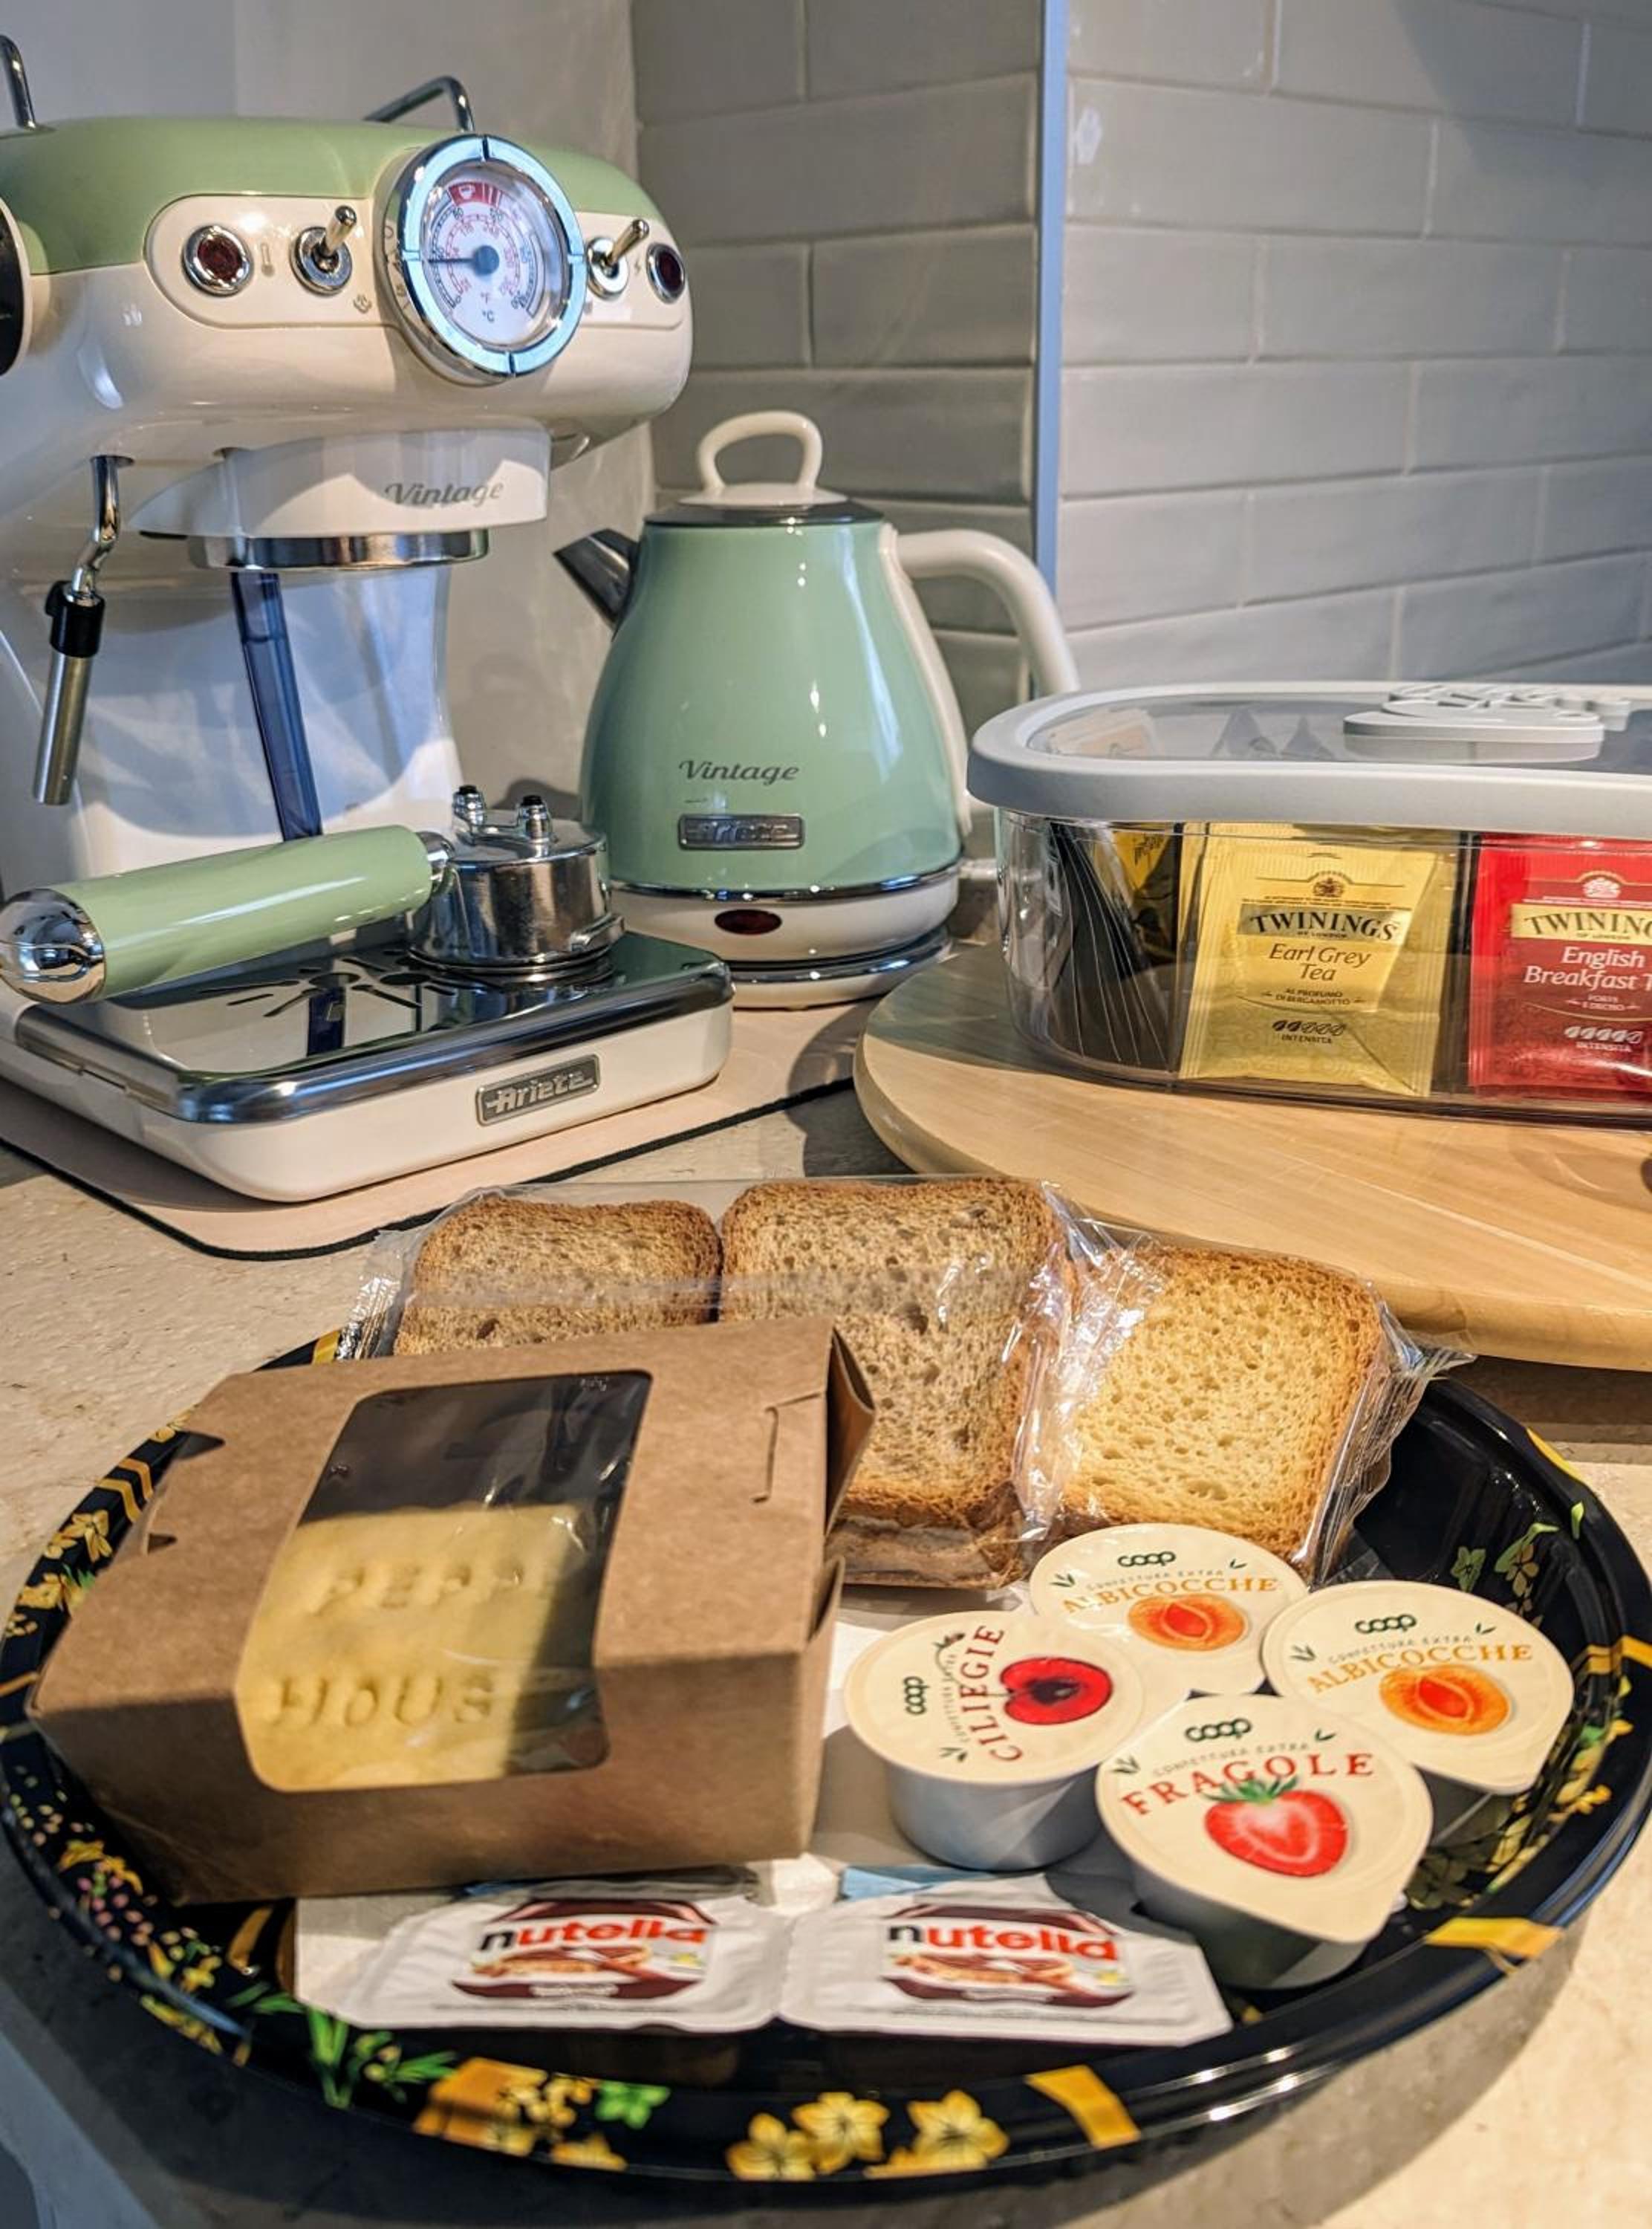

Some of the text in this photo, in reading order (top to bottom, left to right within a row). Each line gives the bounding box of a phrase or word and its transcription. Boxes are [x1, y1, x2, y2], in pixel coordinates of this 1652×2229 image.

[384, 481, 504, 508] Vintage
[678, 759, 800, 786] Vintage
[1250, 912, 1397, 941] TWININGS
[1269, 942, 1372, 969] Earl Grey
[1561, 946, 1646, 969] English
[1300, 964, 1336, 982] Tea
[1524, 965, 1639, 992] Breakfast
[487, 1071, 594, 1114] Ariete
[1117, 1551, 1177, 1568] coop
[1354, 1613, 1417, 1635] coop
[1307, 1644, 1533, 1694] ALBICOCCHE
[959, 1625, 1024, 1762] CILIEGIE
[1184, 1717, 1252, 1741] coop
[1121, 1752, 1374, 1815] FRAGOLE
[479, 1918, 709, 1952] nutella
[887, 1924, 1119, 1962] nutella
